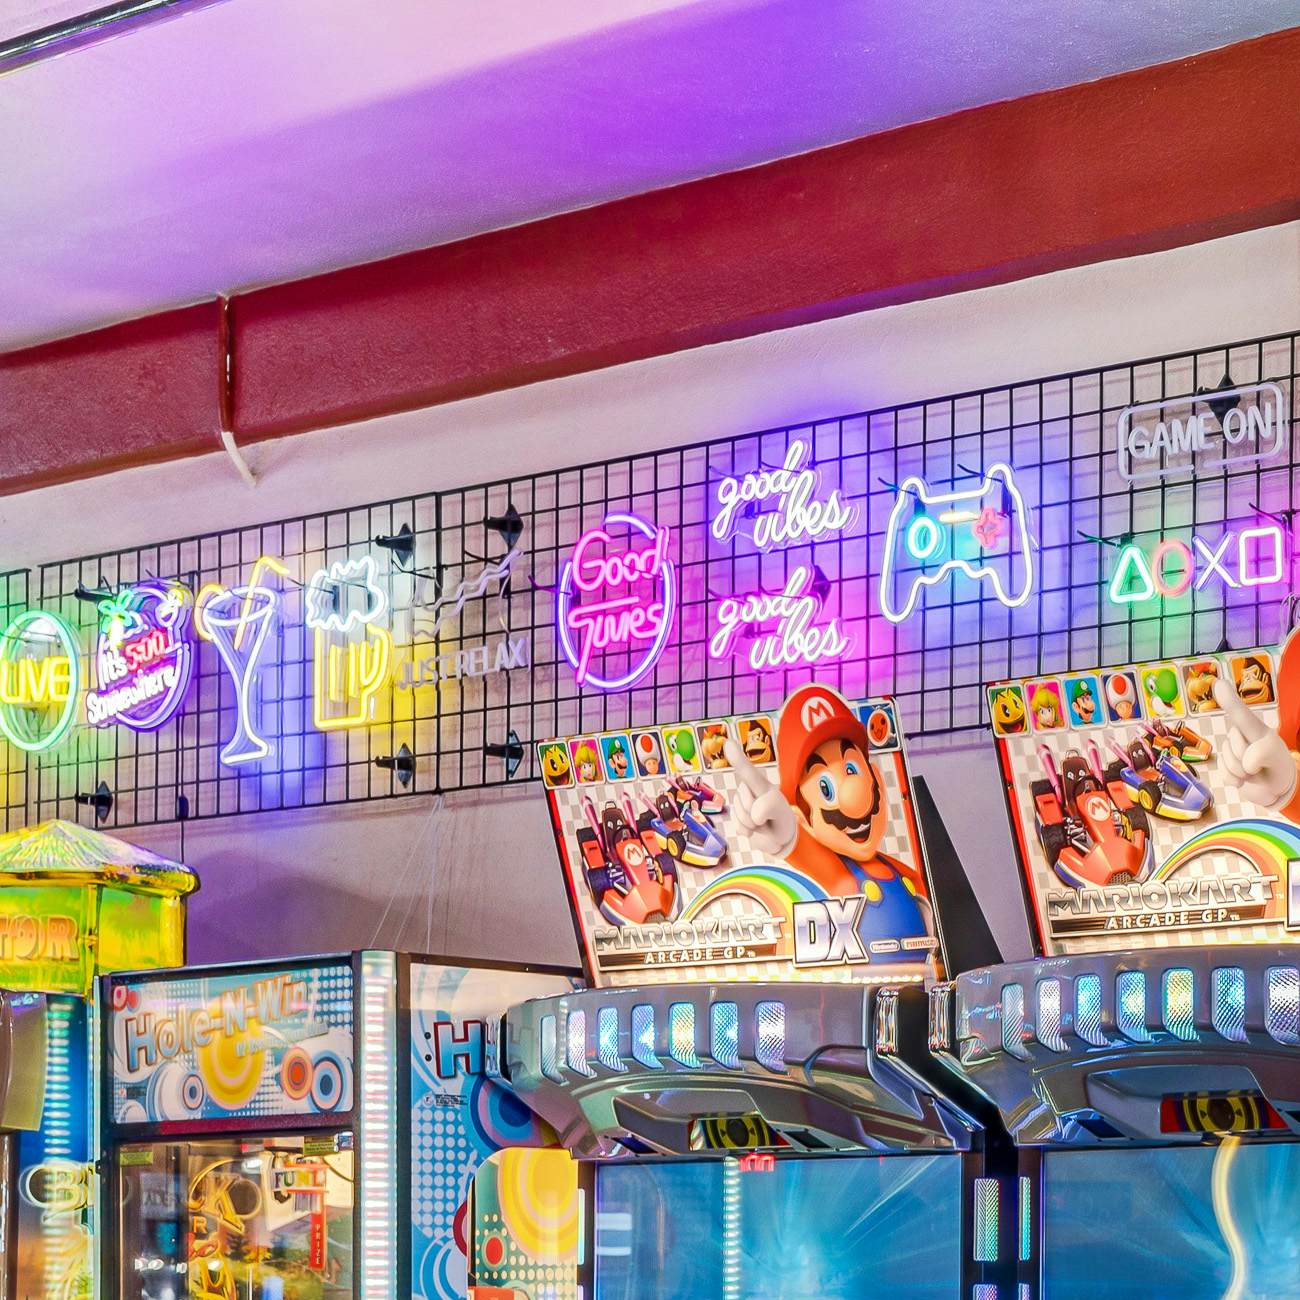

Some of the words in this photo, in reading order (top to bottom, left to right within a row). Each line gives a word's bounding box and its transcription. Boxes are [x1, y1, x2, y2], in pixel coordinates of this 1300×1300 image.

[1127, 409, 1216, 459] GAME
[1223, 402, 1273, 445] ON
[713, 440, 810, 540] good
[753, 470, 850, 547] vibes
[573, 526, 670, 591] Good
[568, 597, 663, 686] Times
[710, 566, 806, 659] good
[749, 598, 849, 669] vibes
[0, 656, 70, 702] LIVE
[398, 653, 447, 691] JUST
[453, 637, 529, 681] RELAX
[794, 896, 866, 966] DX
[1106, 909, 1190, 930] ARCADE
[645, 947, 714, 965] ARCADE
